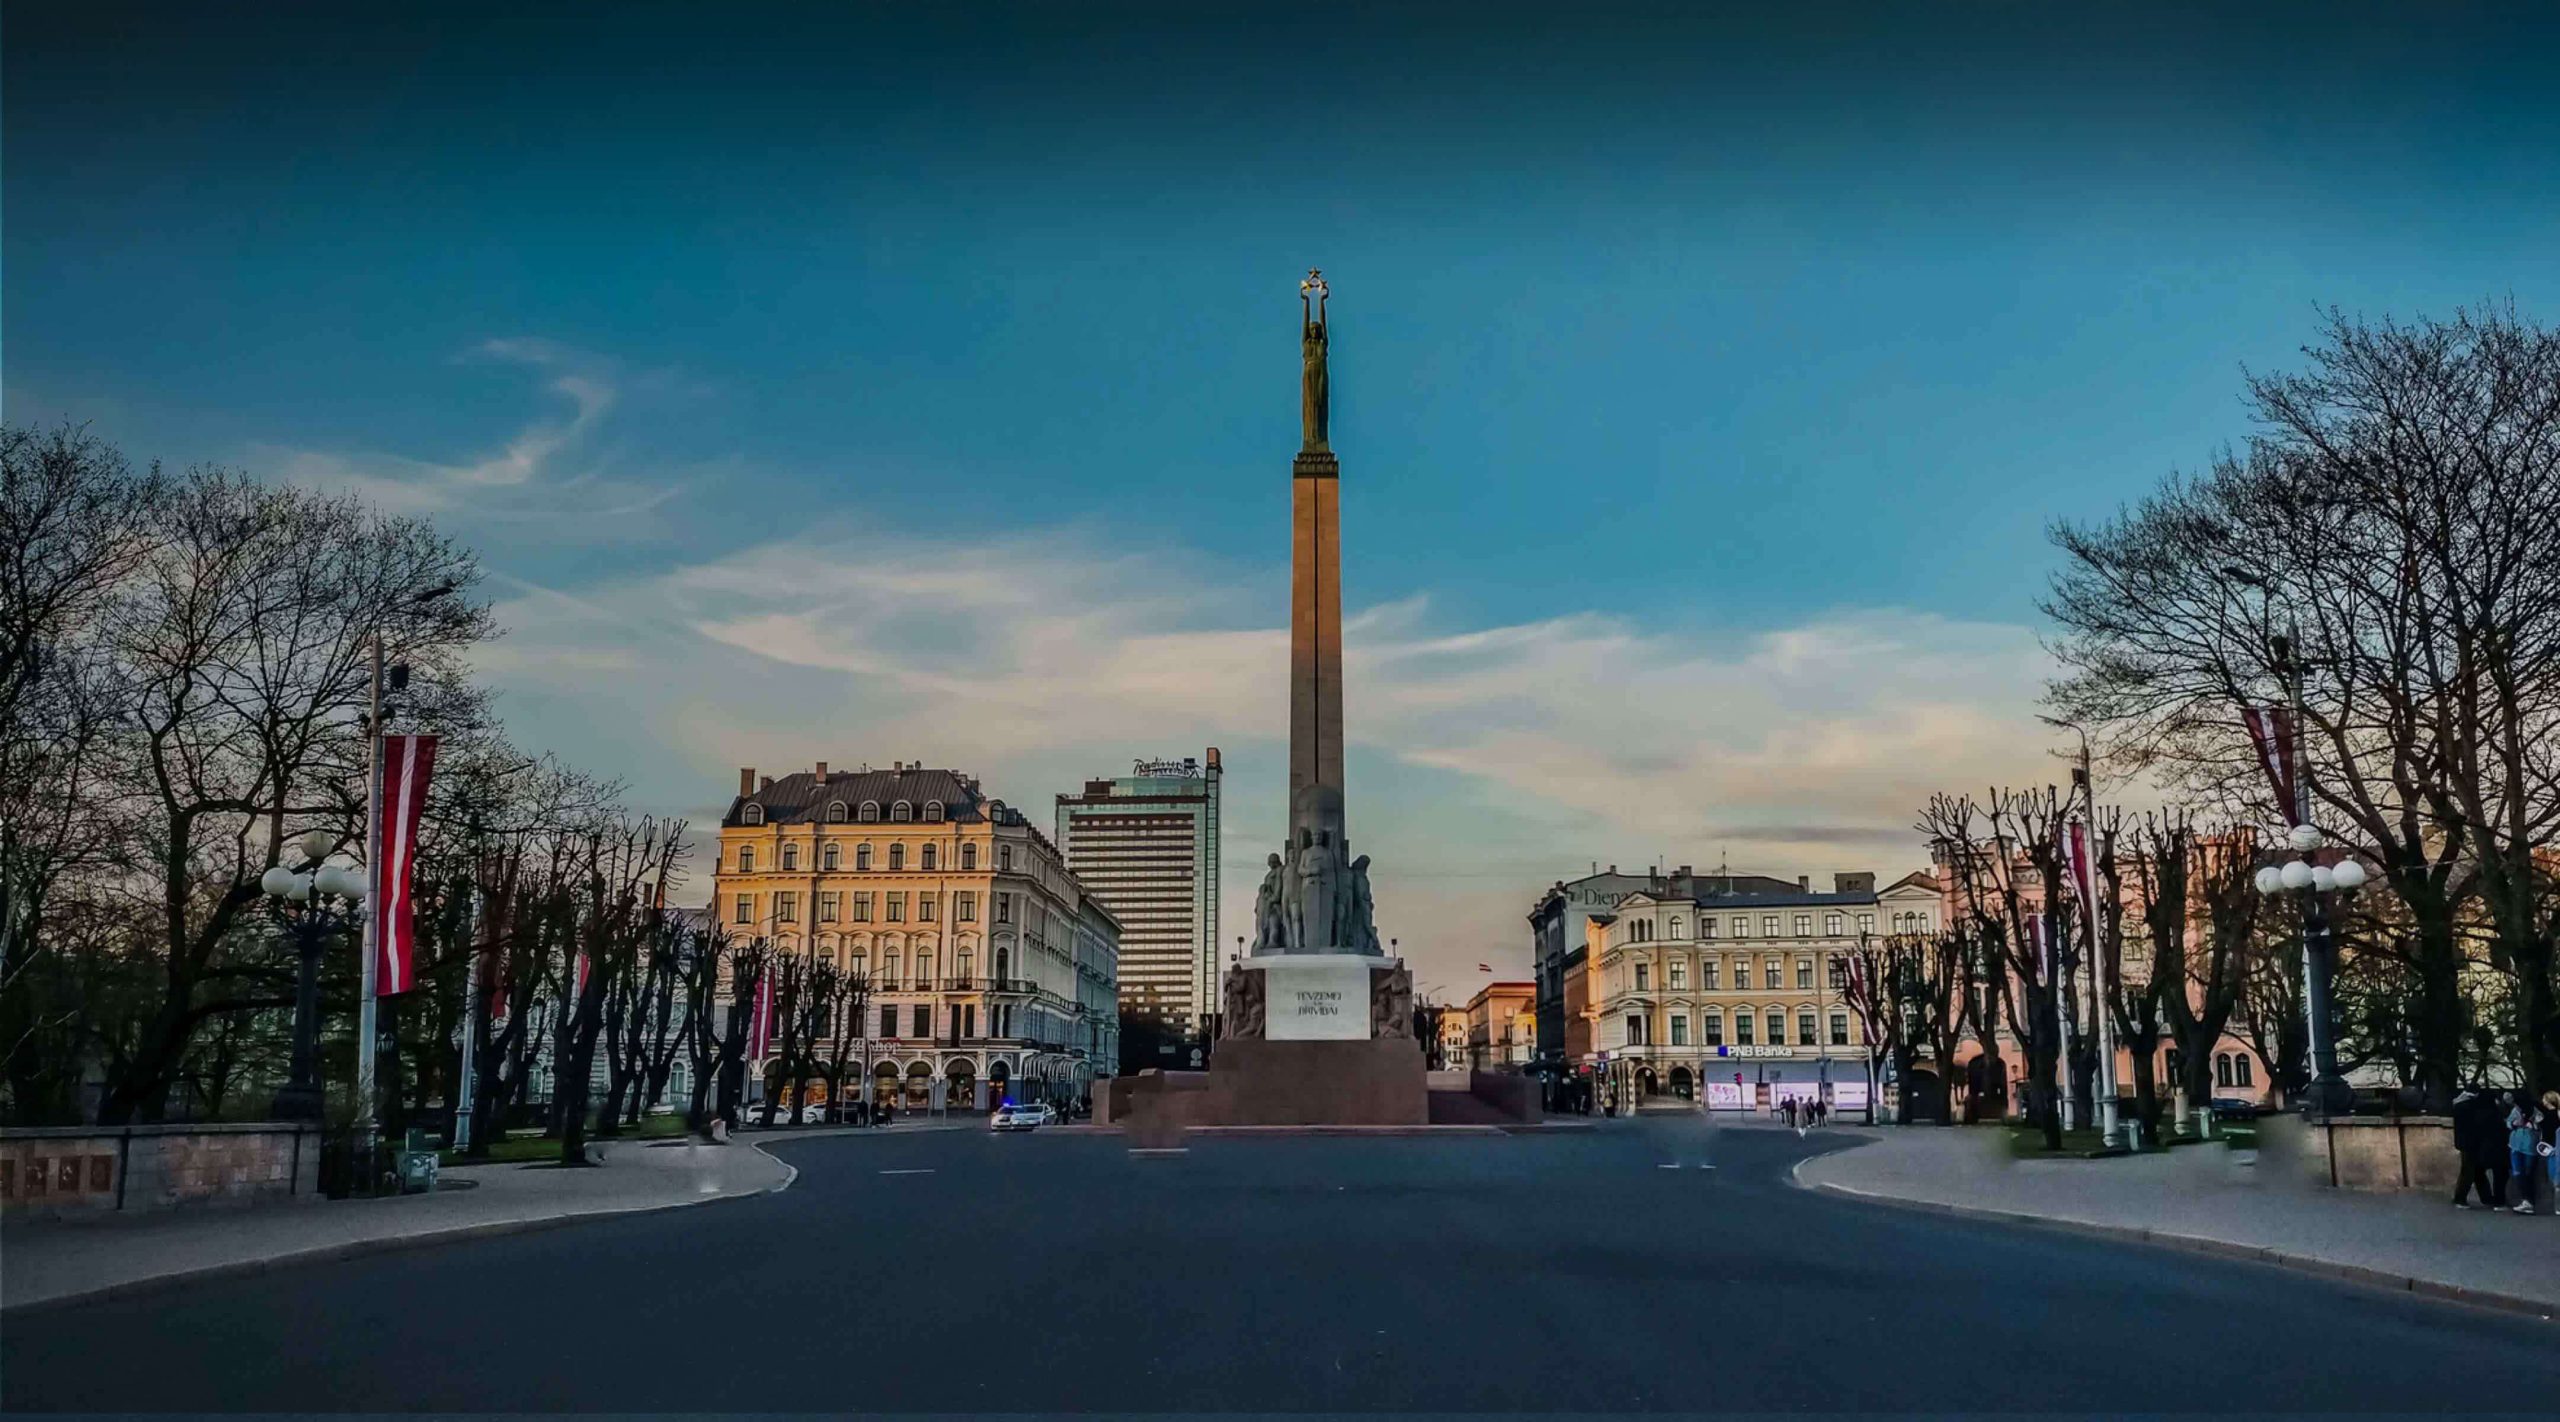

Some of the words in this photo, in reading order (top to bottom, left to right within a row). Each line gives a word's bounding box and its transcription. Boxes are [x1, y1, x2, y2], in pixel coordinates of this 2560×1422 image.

[1133, 756, 1183, 775] Radisson
[1728, 1045, 1753, 1057] PNB
[1754, 1045, 1793, 1057] Banka
